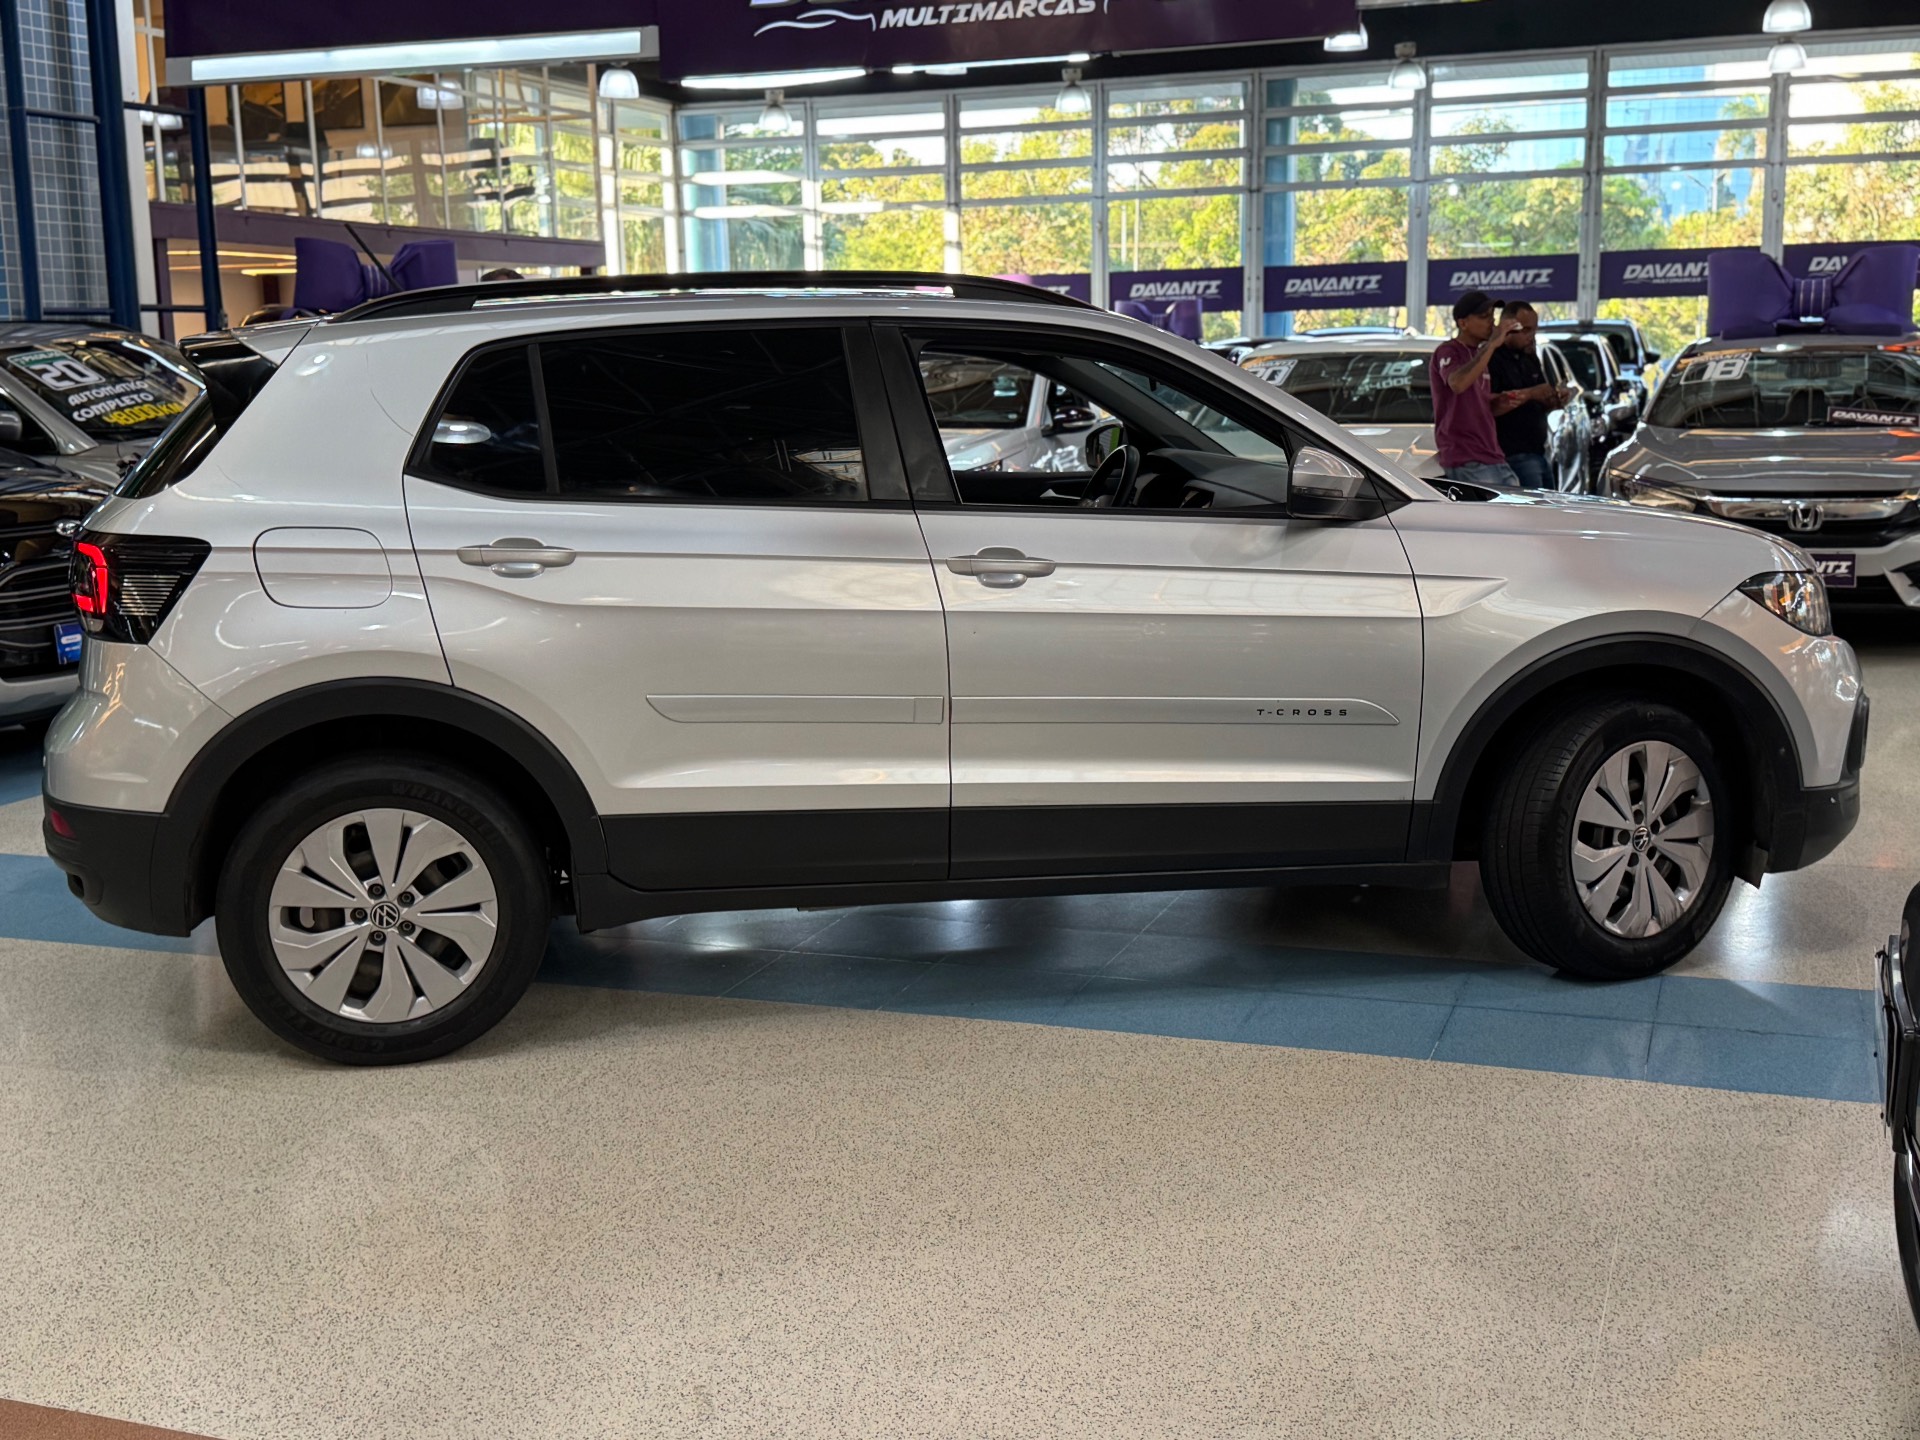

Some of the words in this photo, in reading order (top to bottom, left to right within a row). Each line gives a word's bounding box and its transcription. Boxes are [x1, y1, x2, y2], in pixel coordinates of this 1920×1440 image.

[879, 0, 1096, 30] MULTIMARCAS
[1449, 268, 1554, 287] DAVANTI
[1622, 261, 1709, 280] DAVANT
[1129, 280, 1222, 298] DAVANTI
[1284, 274, 1382, 293] DAVANTI
[29, 360, 100, 388] 20
[1702, 359, 1744, 380] 18
[72, 392, 154, 422] COMPLETO
[1832, 410, 1917, 425] DAVANTI
[1256, 708, 1348, 717] T-CROSS
